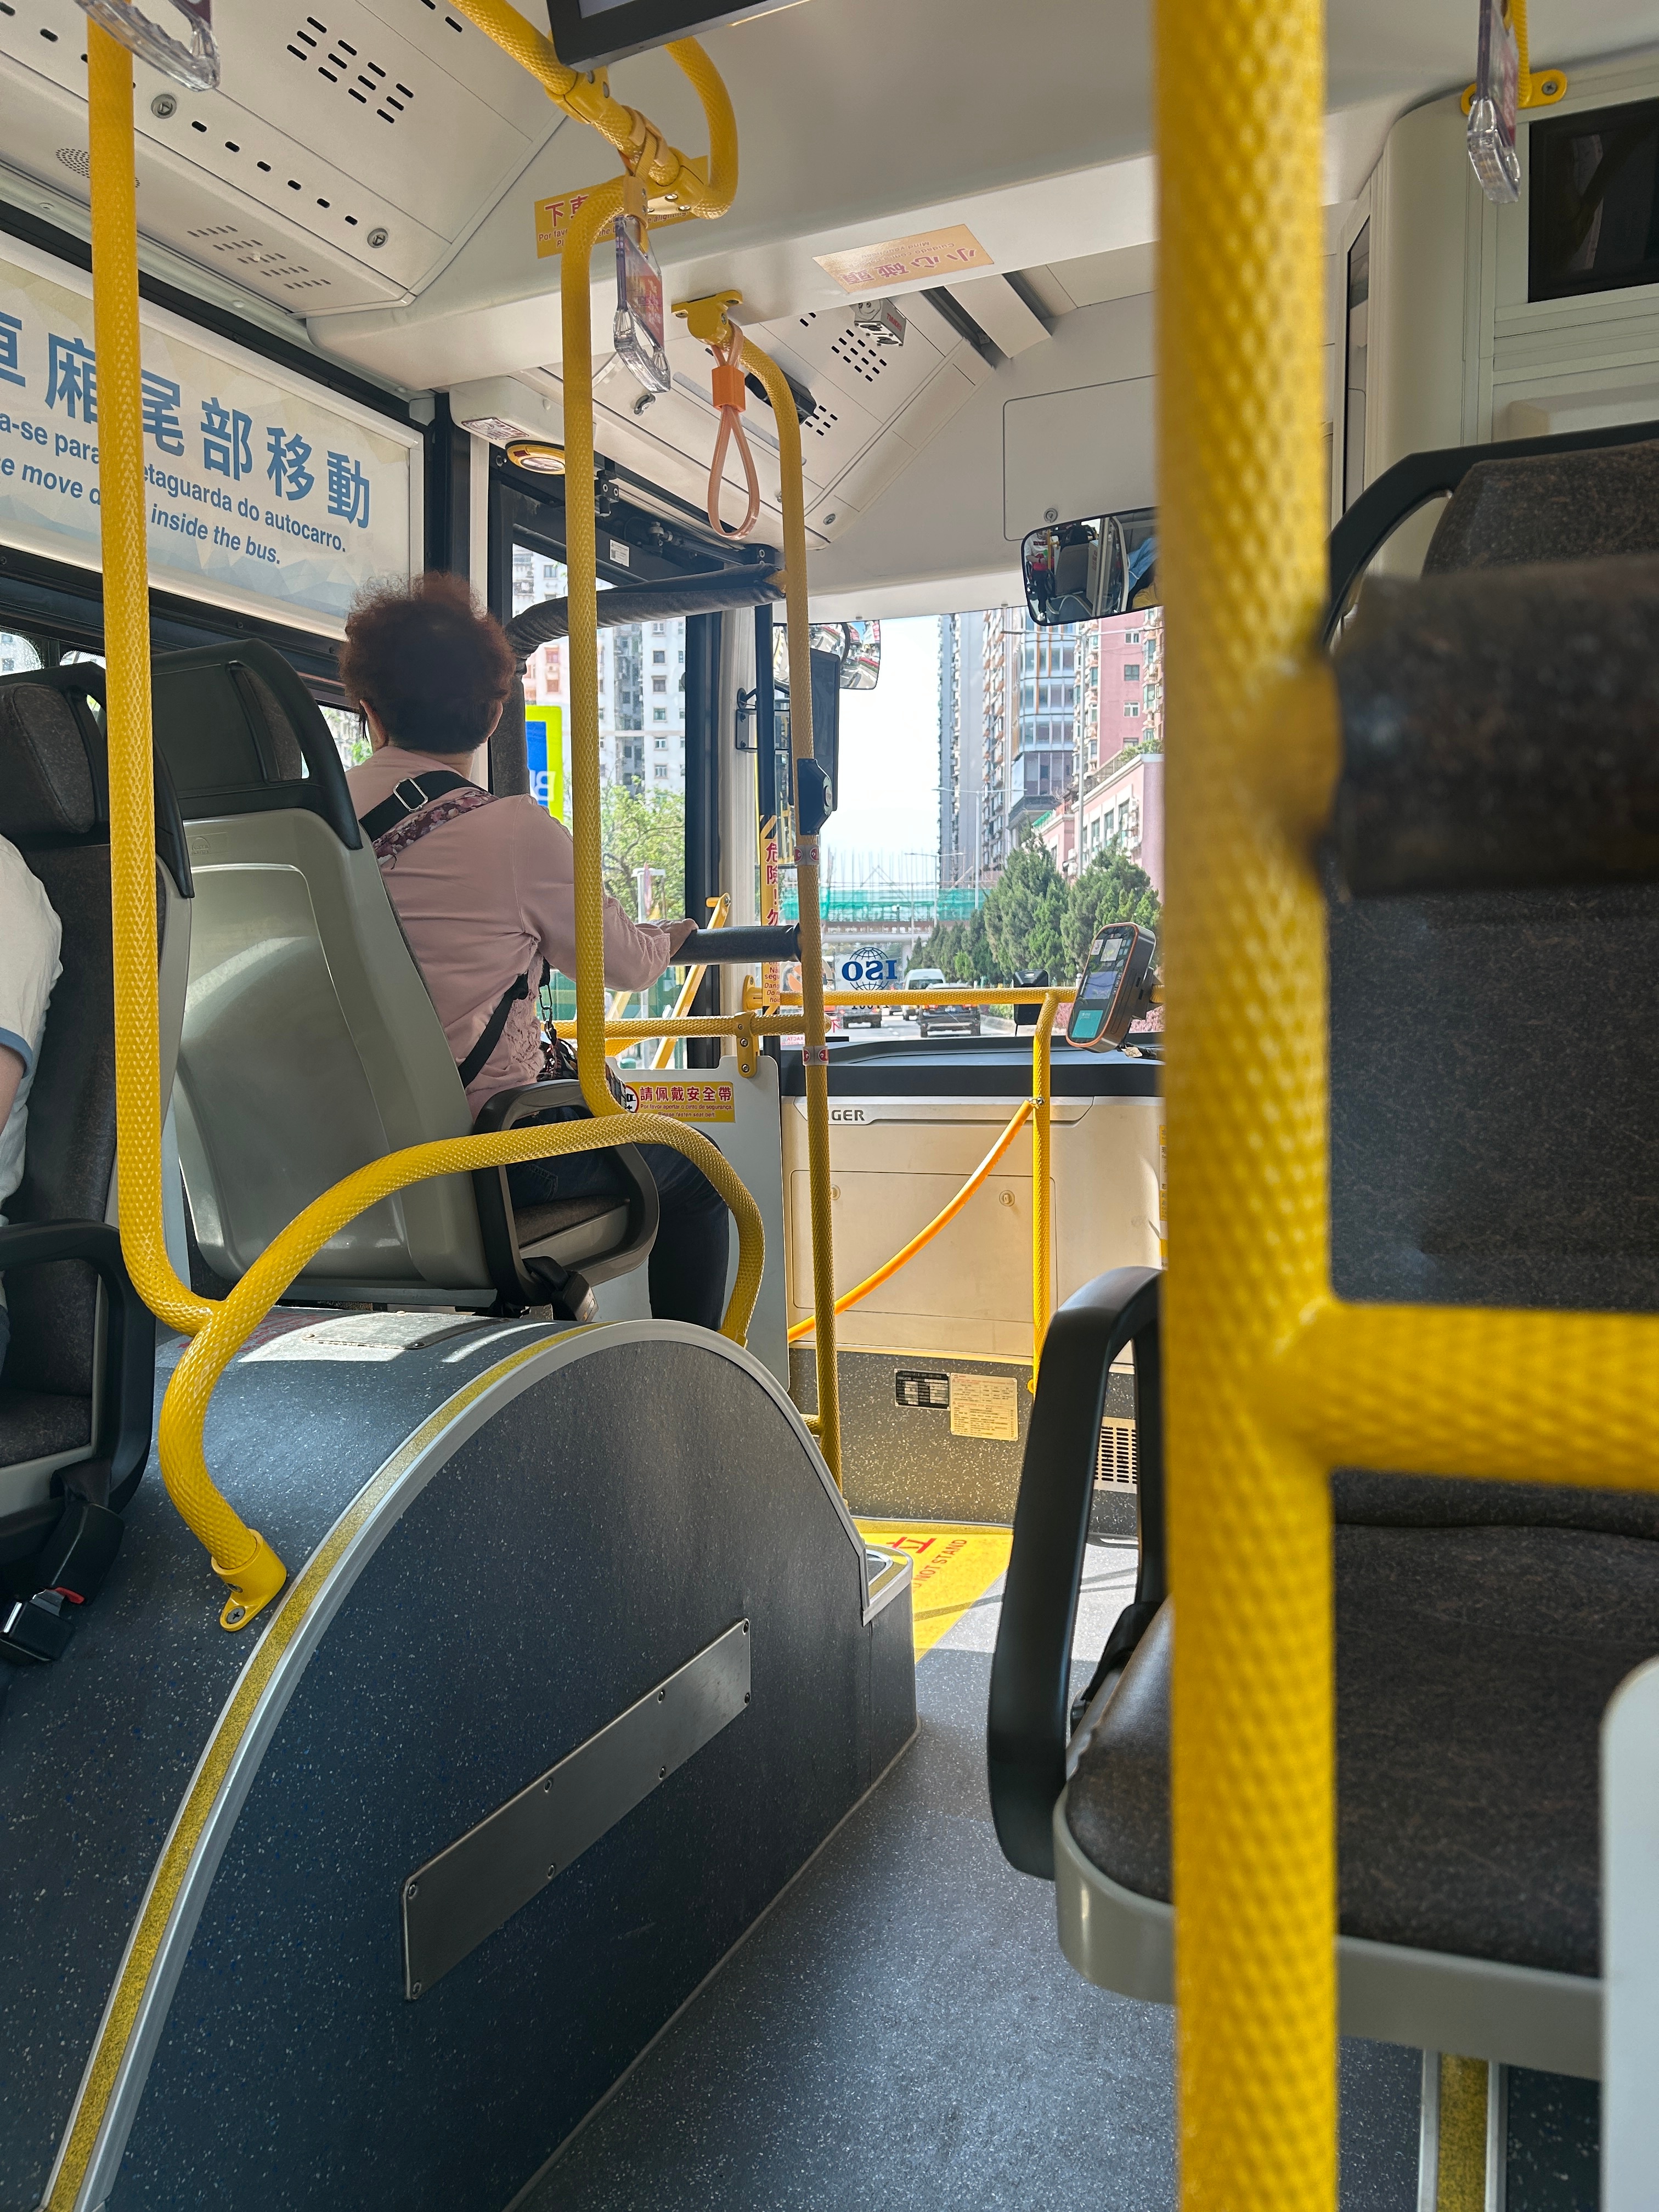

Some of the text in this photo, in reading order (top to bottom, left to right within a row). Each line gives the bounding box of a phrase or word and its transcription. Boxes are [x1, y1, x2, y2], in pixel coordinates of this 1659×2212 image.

[539, 229, 568, 241] Por fav
[908, 241, 930, 250] Mind
[915, 242, 955, 254] Cuidado
[22, 464, 83, 498] move
[151, 504, 208, 540] inside
[213, 526, 241, 551] the
[246, 536, 280, 564] bus.
[238, 498, 260, 521] do
[265, 511, 346, 552] autocarro.
[640, 1086, 731, 1102] 請佩戴安全帶
[827, 1109, 865, 1121] GER
[913, 1565, 941, 1581] NOT
[931, 1539, 967, 1564] STAND
